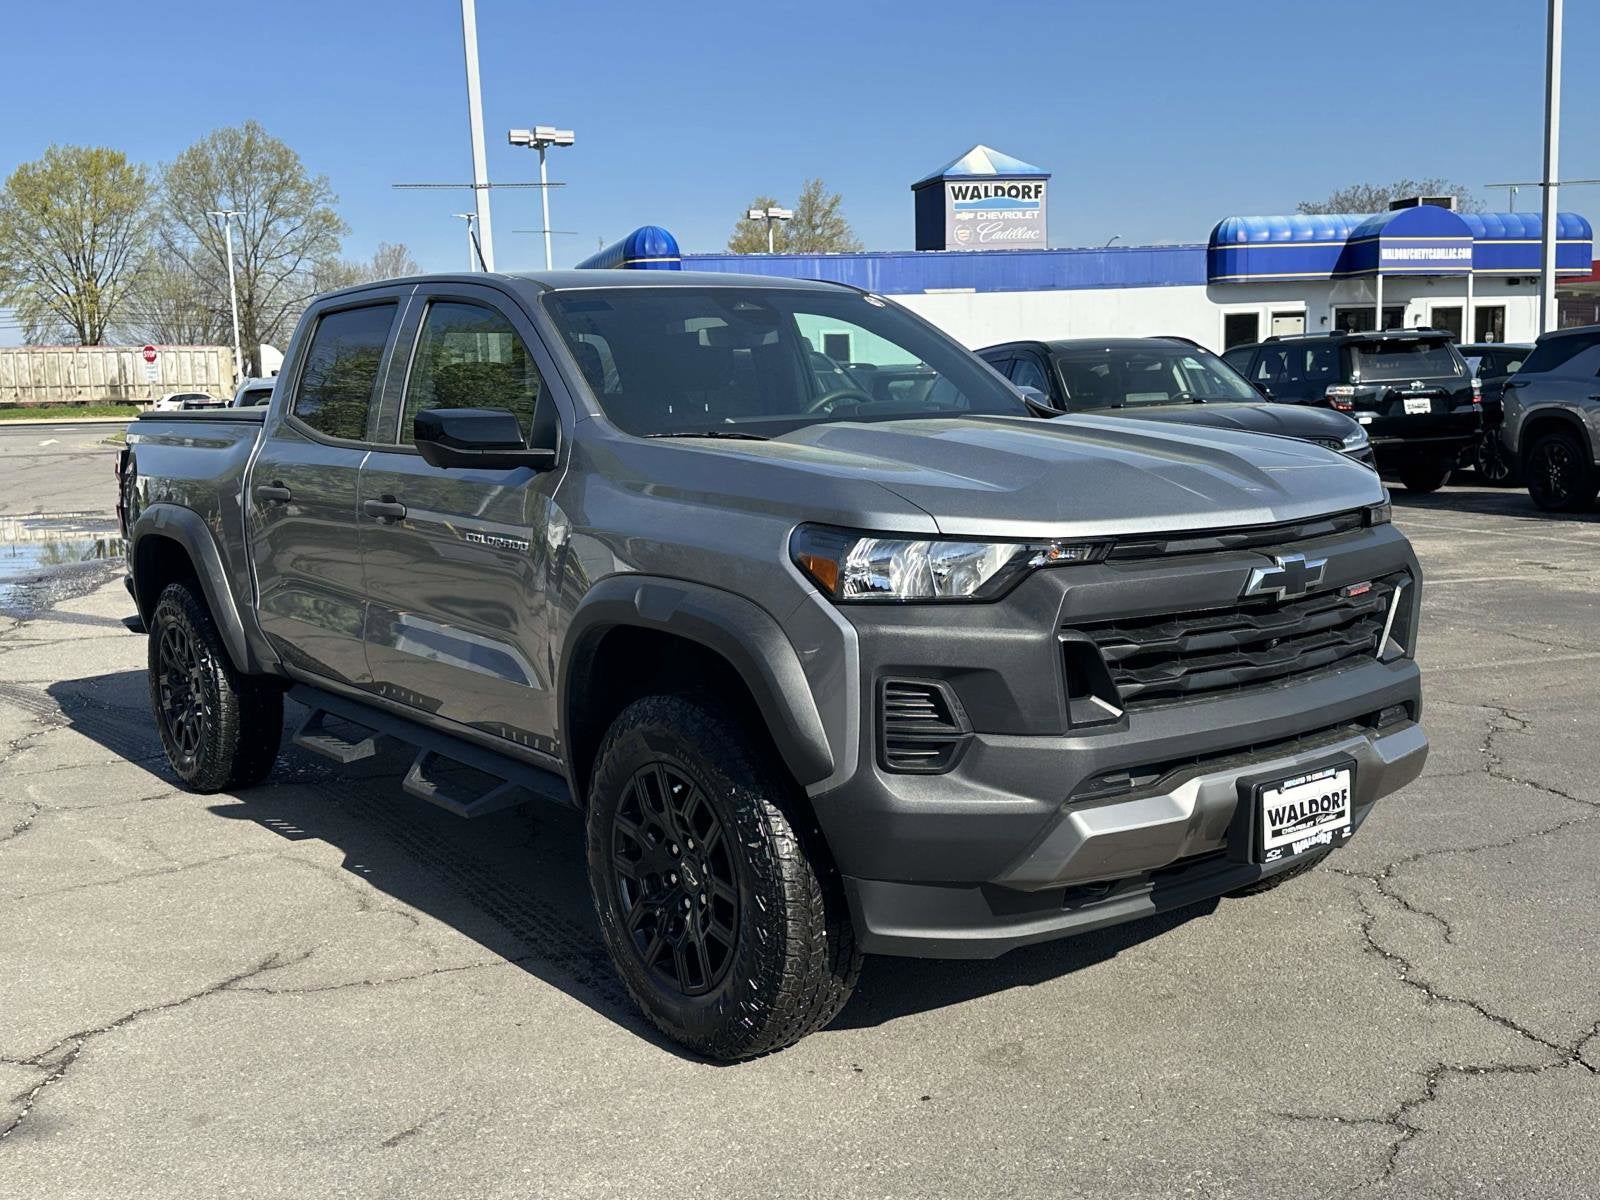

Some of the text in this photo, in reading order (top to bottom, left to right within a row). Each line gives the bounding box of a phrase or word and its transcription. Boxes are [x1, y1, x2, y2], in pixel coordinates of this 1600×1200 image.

[950, 185, 1042, 200] WALDORF
[977, 211, 1040, 220] CHEVROLET
[976, 221, 1040, 243] Cadillac
[143, 350, 156, 358] STOP
[466, 532, 529, 551] COLORADO
[1267, 789, 1347, 827] WALDORF
[1292, 831, 1332, 855] WALDORF
